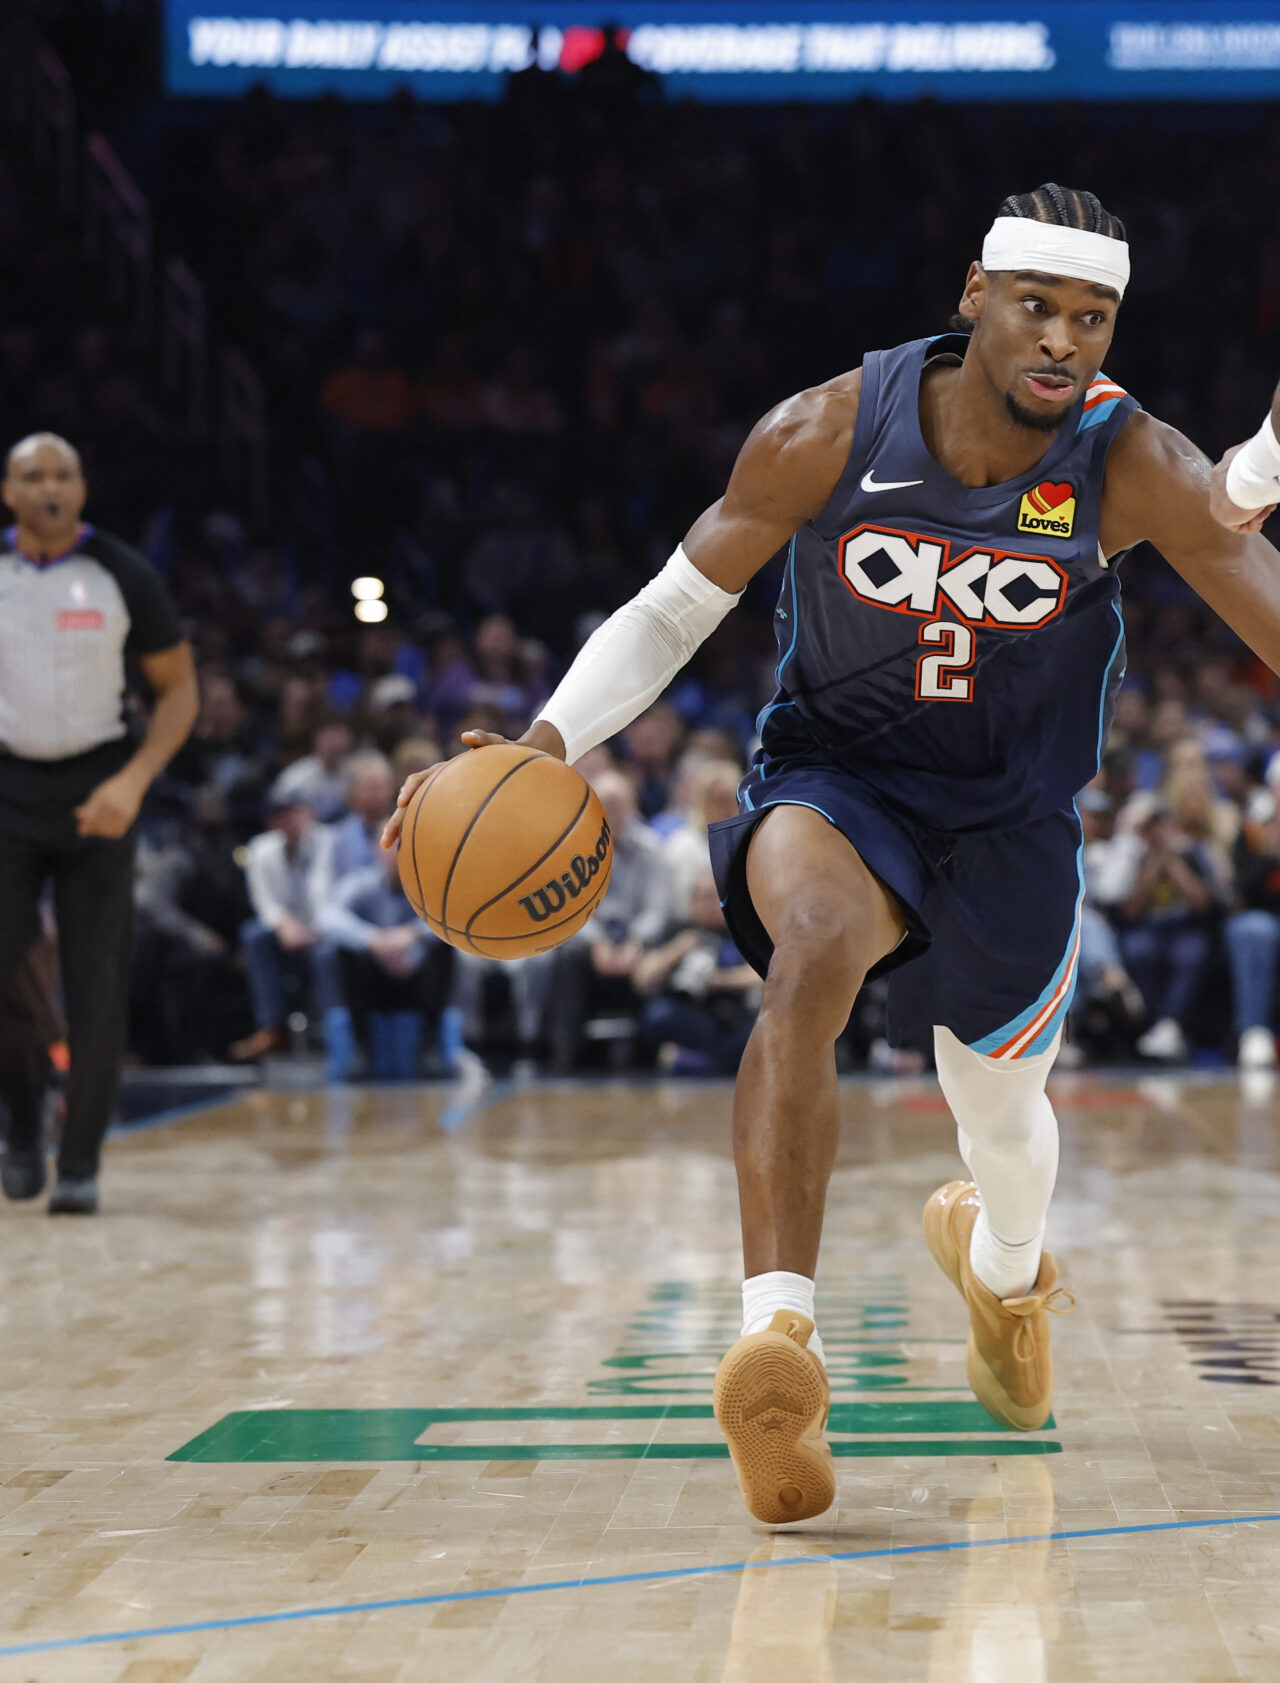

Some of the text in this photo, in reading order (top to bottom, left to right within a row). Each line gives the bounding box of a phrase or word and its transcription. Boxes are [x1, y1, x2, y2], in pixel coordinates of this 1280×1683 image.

[838, 523, 1069, 630] OKC
[914, 620, 976, 702] 2
[518, 817, 611, 922] Wilson
